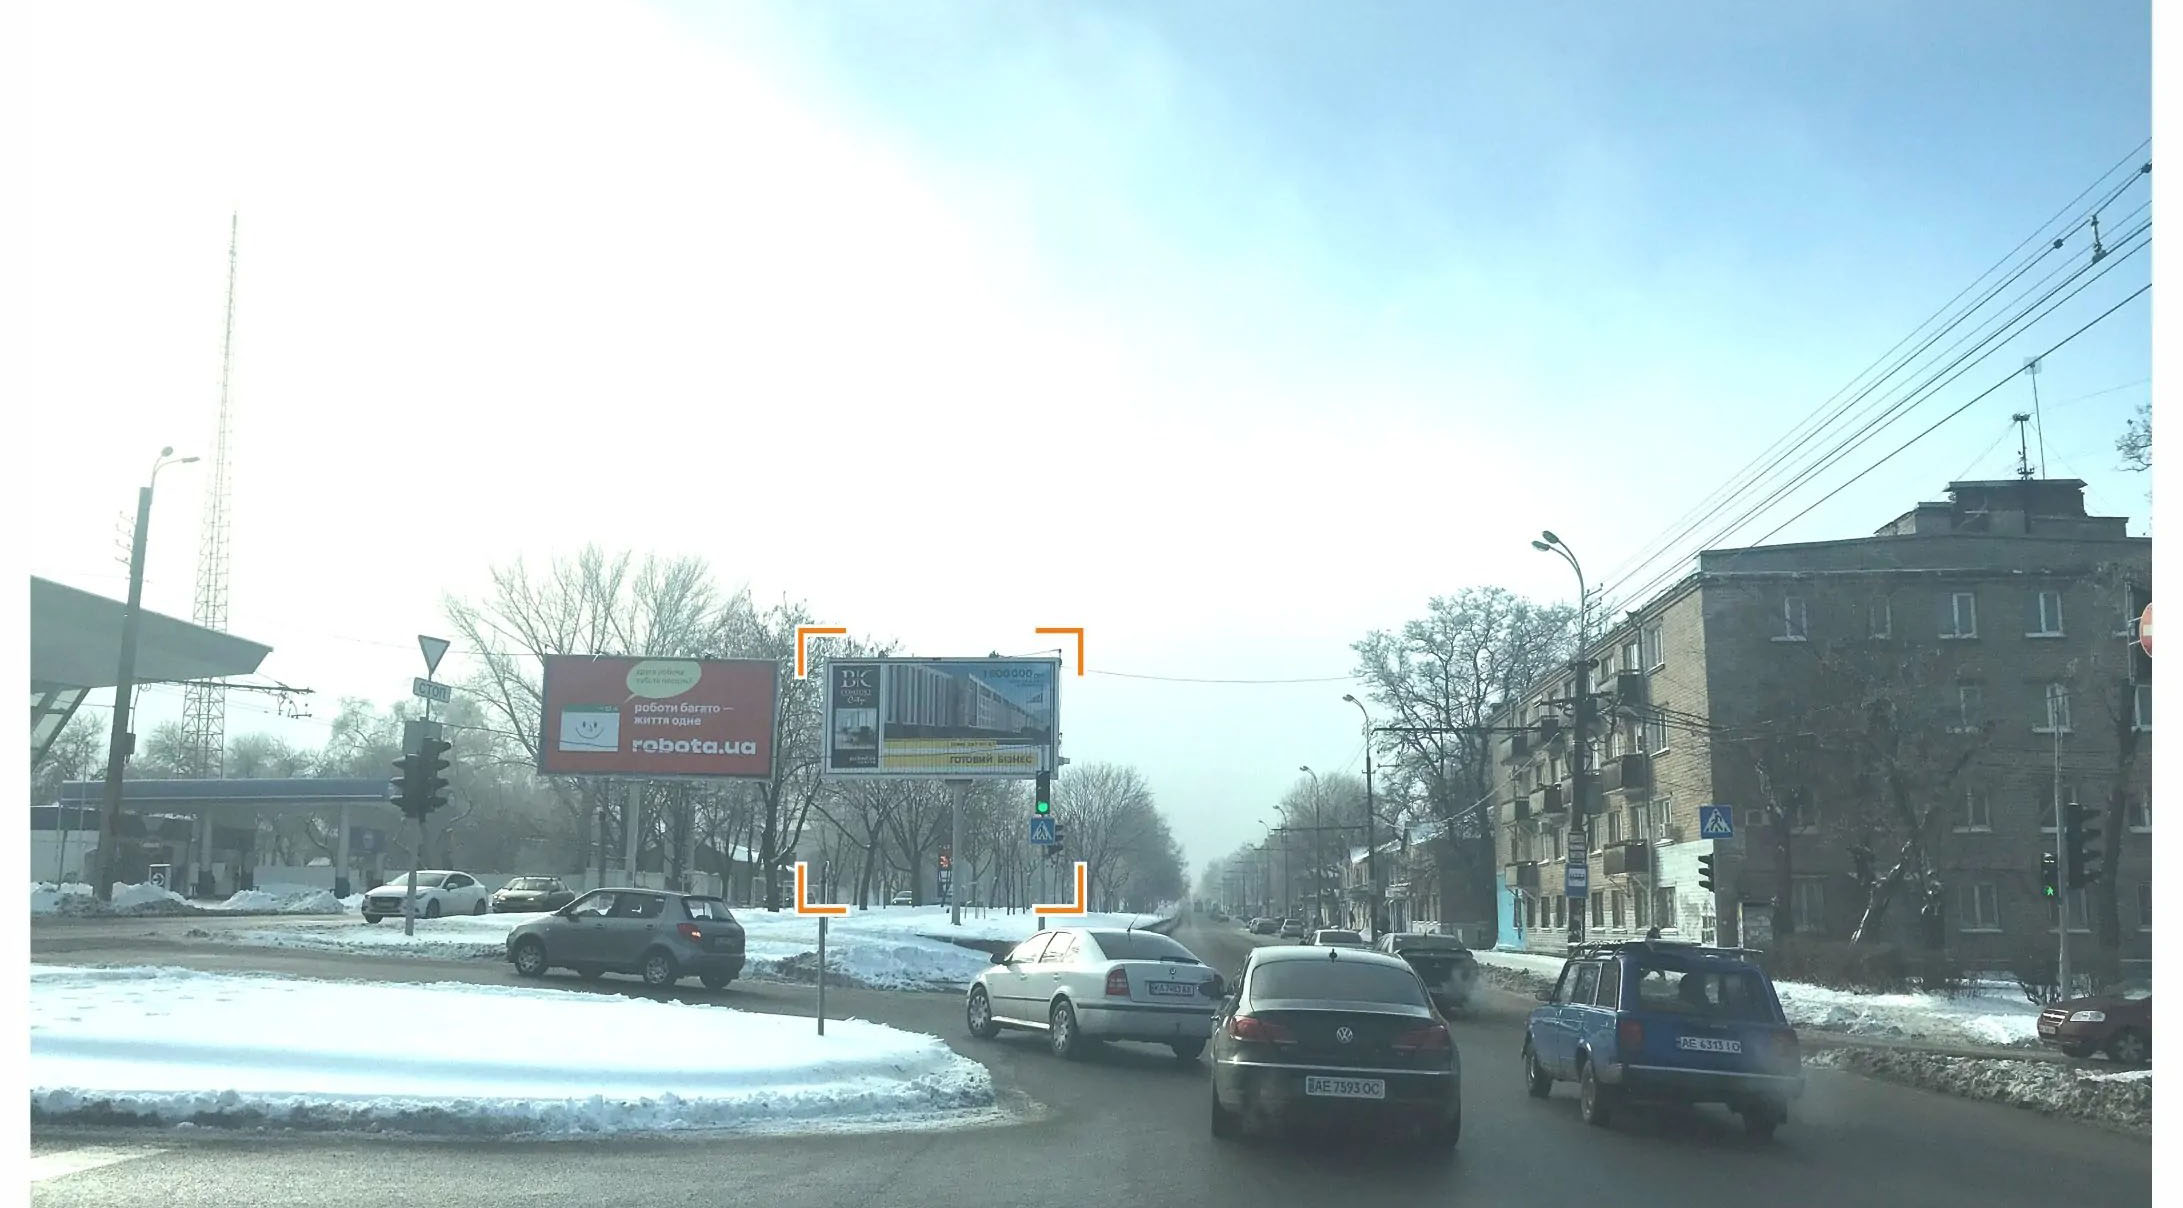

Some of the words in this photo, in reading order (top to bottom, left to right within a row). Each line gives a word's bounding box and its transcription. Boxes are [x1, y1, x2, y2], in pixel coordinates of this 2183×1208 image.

[419, 682, 446, 699] СТОП
[634, 702, 678, 714] роботи
[680, 702, 721, 713] багато
[633, 716, 670, 726] життя
[671, 716, 702, 727] одне
[632, 738, 756, 755] robota.ua
[1682, 1038, 1698, 1049] AE
[1315, 1079, 1332, 1093] AE
[1333, 1081, 1361, 1094] 7593
[1363, 1082, 1381, 1095] OC
